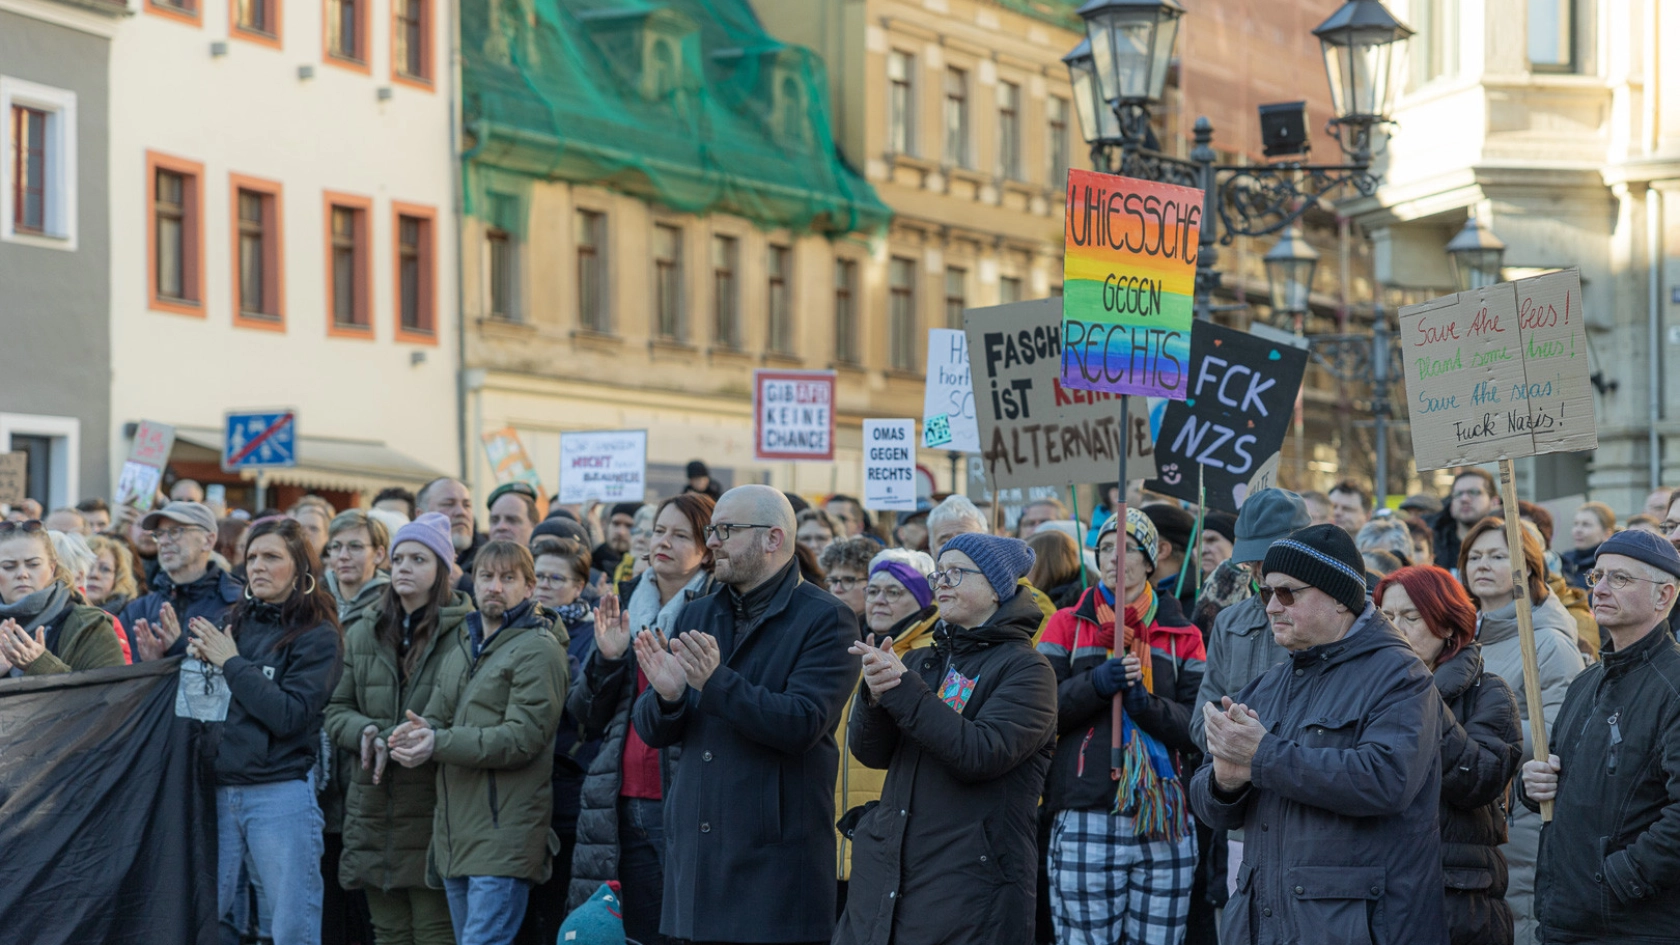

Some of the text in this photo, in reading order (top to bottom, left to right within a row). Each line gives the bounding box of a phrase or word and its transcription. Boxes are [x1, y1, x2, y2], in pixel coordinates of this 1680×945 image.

[1103, 273, 1162, 316] GEGEN
[1414, 317, 1460, 346] Save
[1467, 307, 1505, 337] the
[984, 321, 1062, 378] FASCH
[1064, 320, 1181, 390] RECHTS
[1415, 346, 1462, 380] Plant
[1472, 345, 1513, 368] some
[767, 383, 794, 403] GIB
[1194, 354, 1276, 417] FCK
[1417, 391, 1460, 414] Save
[1470, 381, 1501, 407] the
[767, 407, 826, 426] KEINE
[1453, 412, 1496, 442] Fuck
[767, 429, 826, 449] CHANCE
[872, 427, 905, 441] OMAS
[1170, 414, 1257, 474] NZS
[572, 455, 613, 469] NICHT
[870, 447, 909, 461] GEGEN
[868, 467, 912, 481] RECHTS
